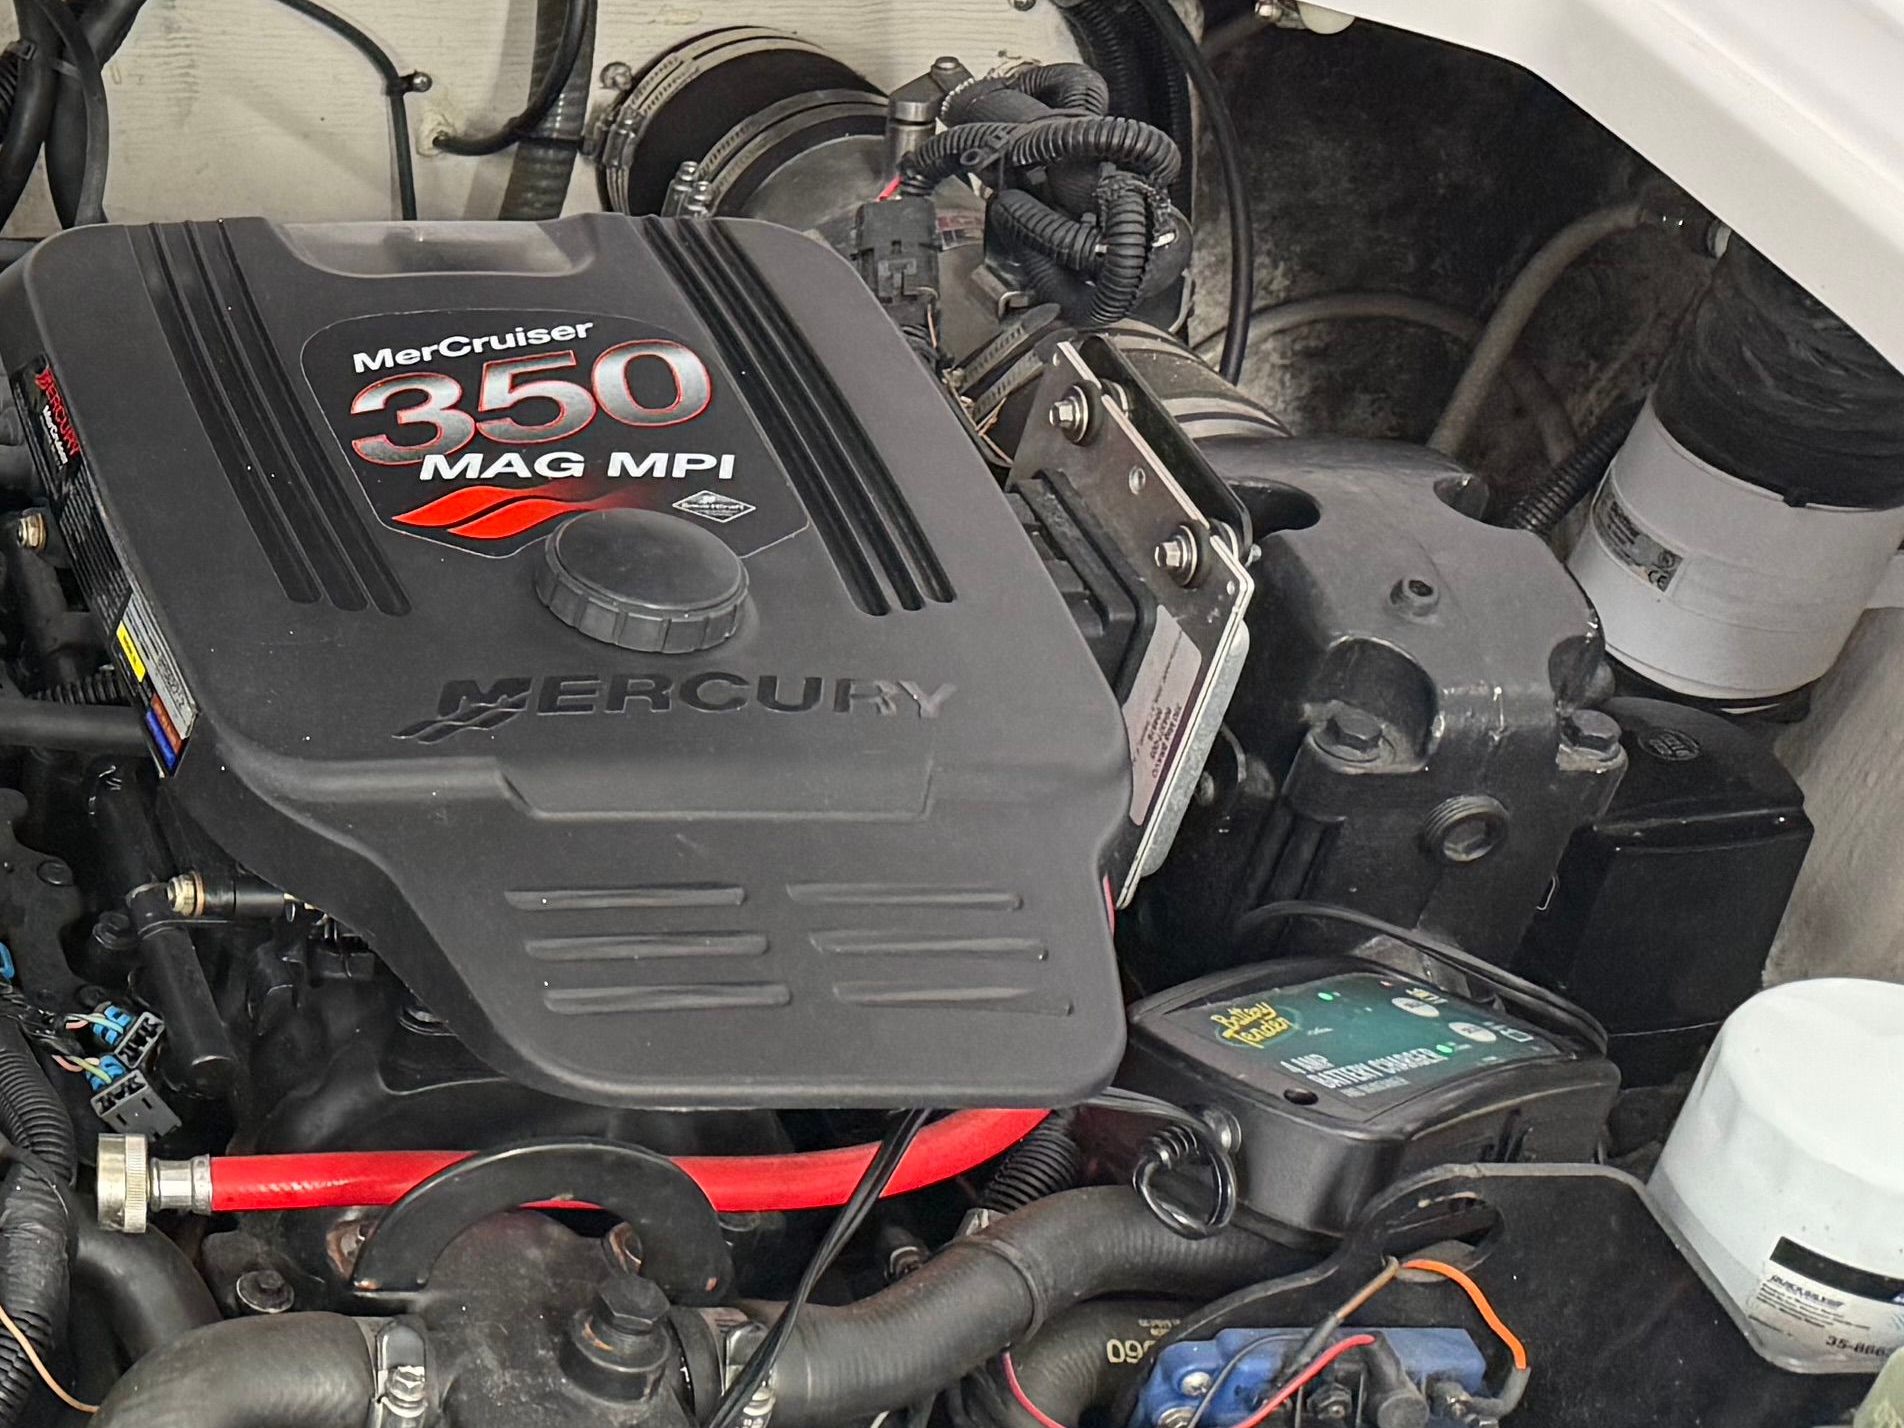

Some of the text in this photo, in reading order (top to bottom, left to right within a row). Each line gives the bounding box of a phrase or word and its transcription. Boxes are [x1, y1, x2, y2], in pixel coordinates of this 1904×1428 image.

[353, 322, 594, 374] MerCruiser
[350, 339, 713, 466] 350
[419, 451, 736, 481] MAG MPI
[410, 672, 957, 744] MERCURY
[1211, 1001, 1278, 1029] Battery
[1223, 1018, 1290, 1049] Tender
[1307, 1060, 1377, 1089] BATTERY
[1367, 1048, 1449, 1076] CHARGER
[1106, 1339, 1156, 1364] 60
